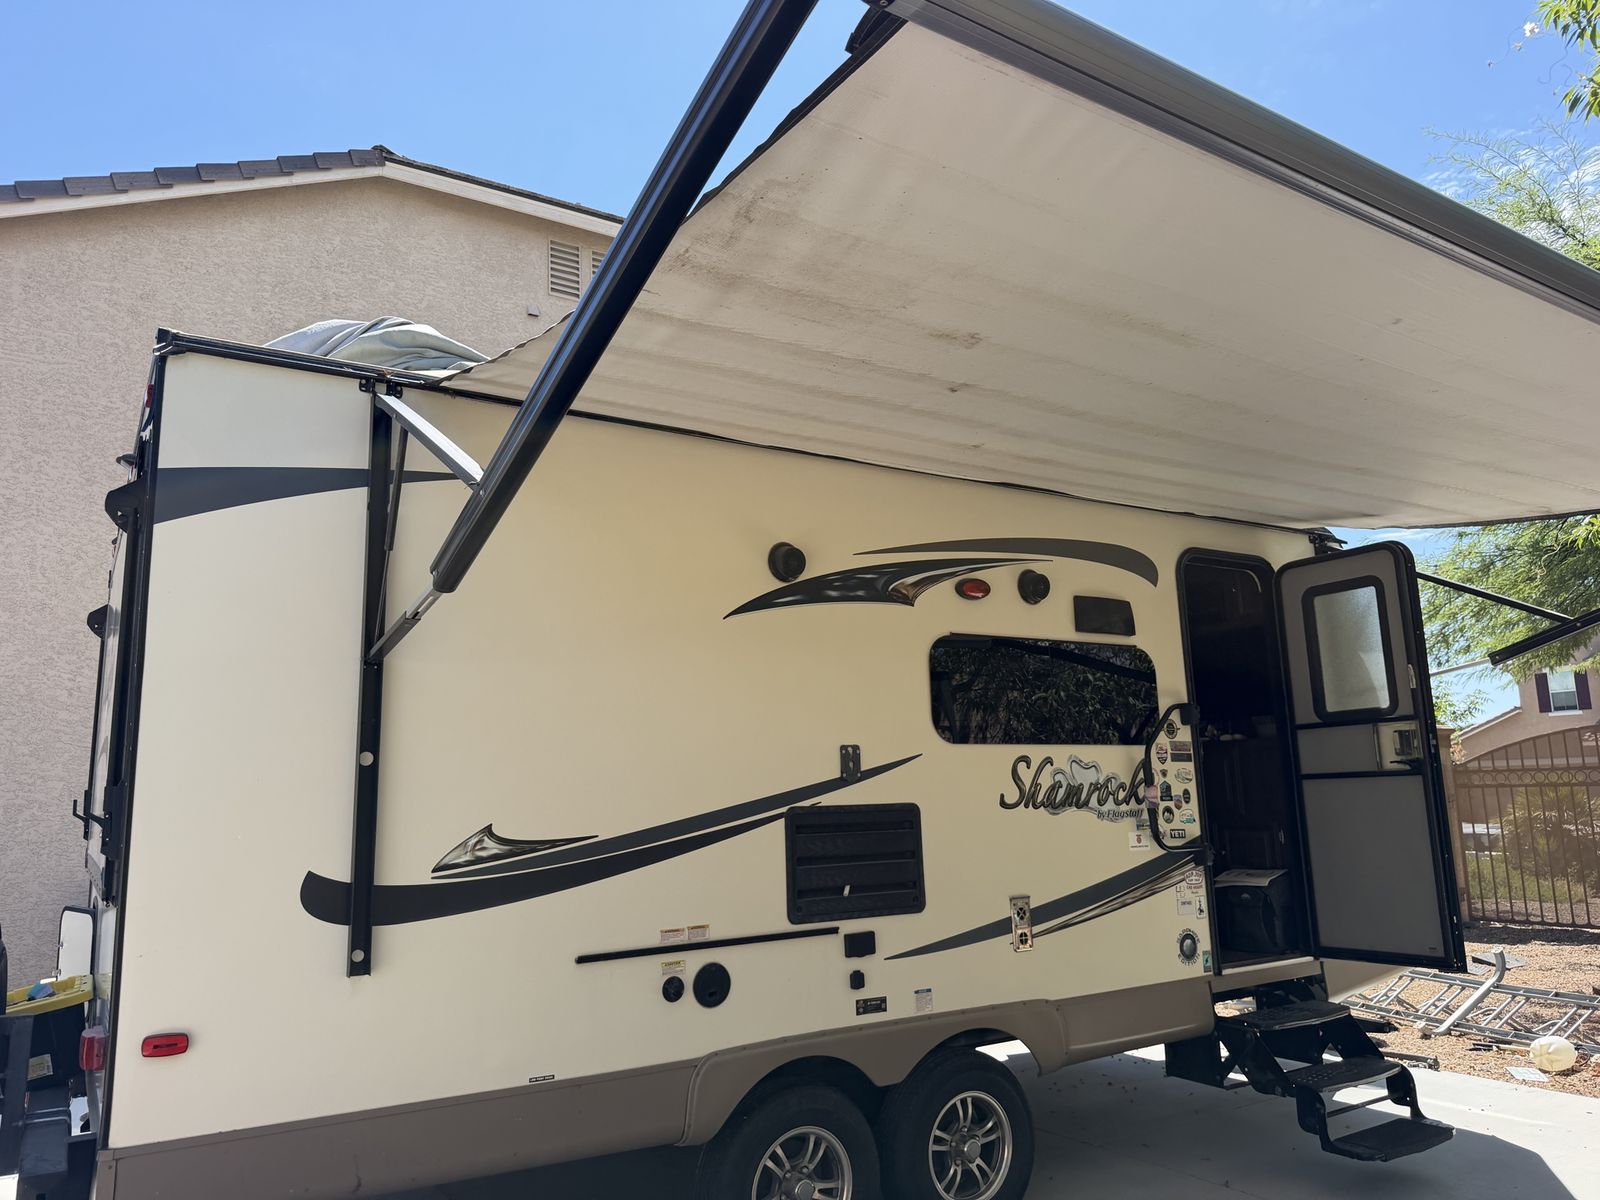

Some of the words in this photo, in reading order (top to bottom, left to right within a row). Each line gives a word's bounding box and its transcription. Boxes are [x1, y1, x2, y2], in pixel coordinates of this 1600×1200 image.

[999, 755, 1147, 810] Shamrock
[1097, 809, 1106, 821] by
[1170, 830, 1185, 838] YETI
